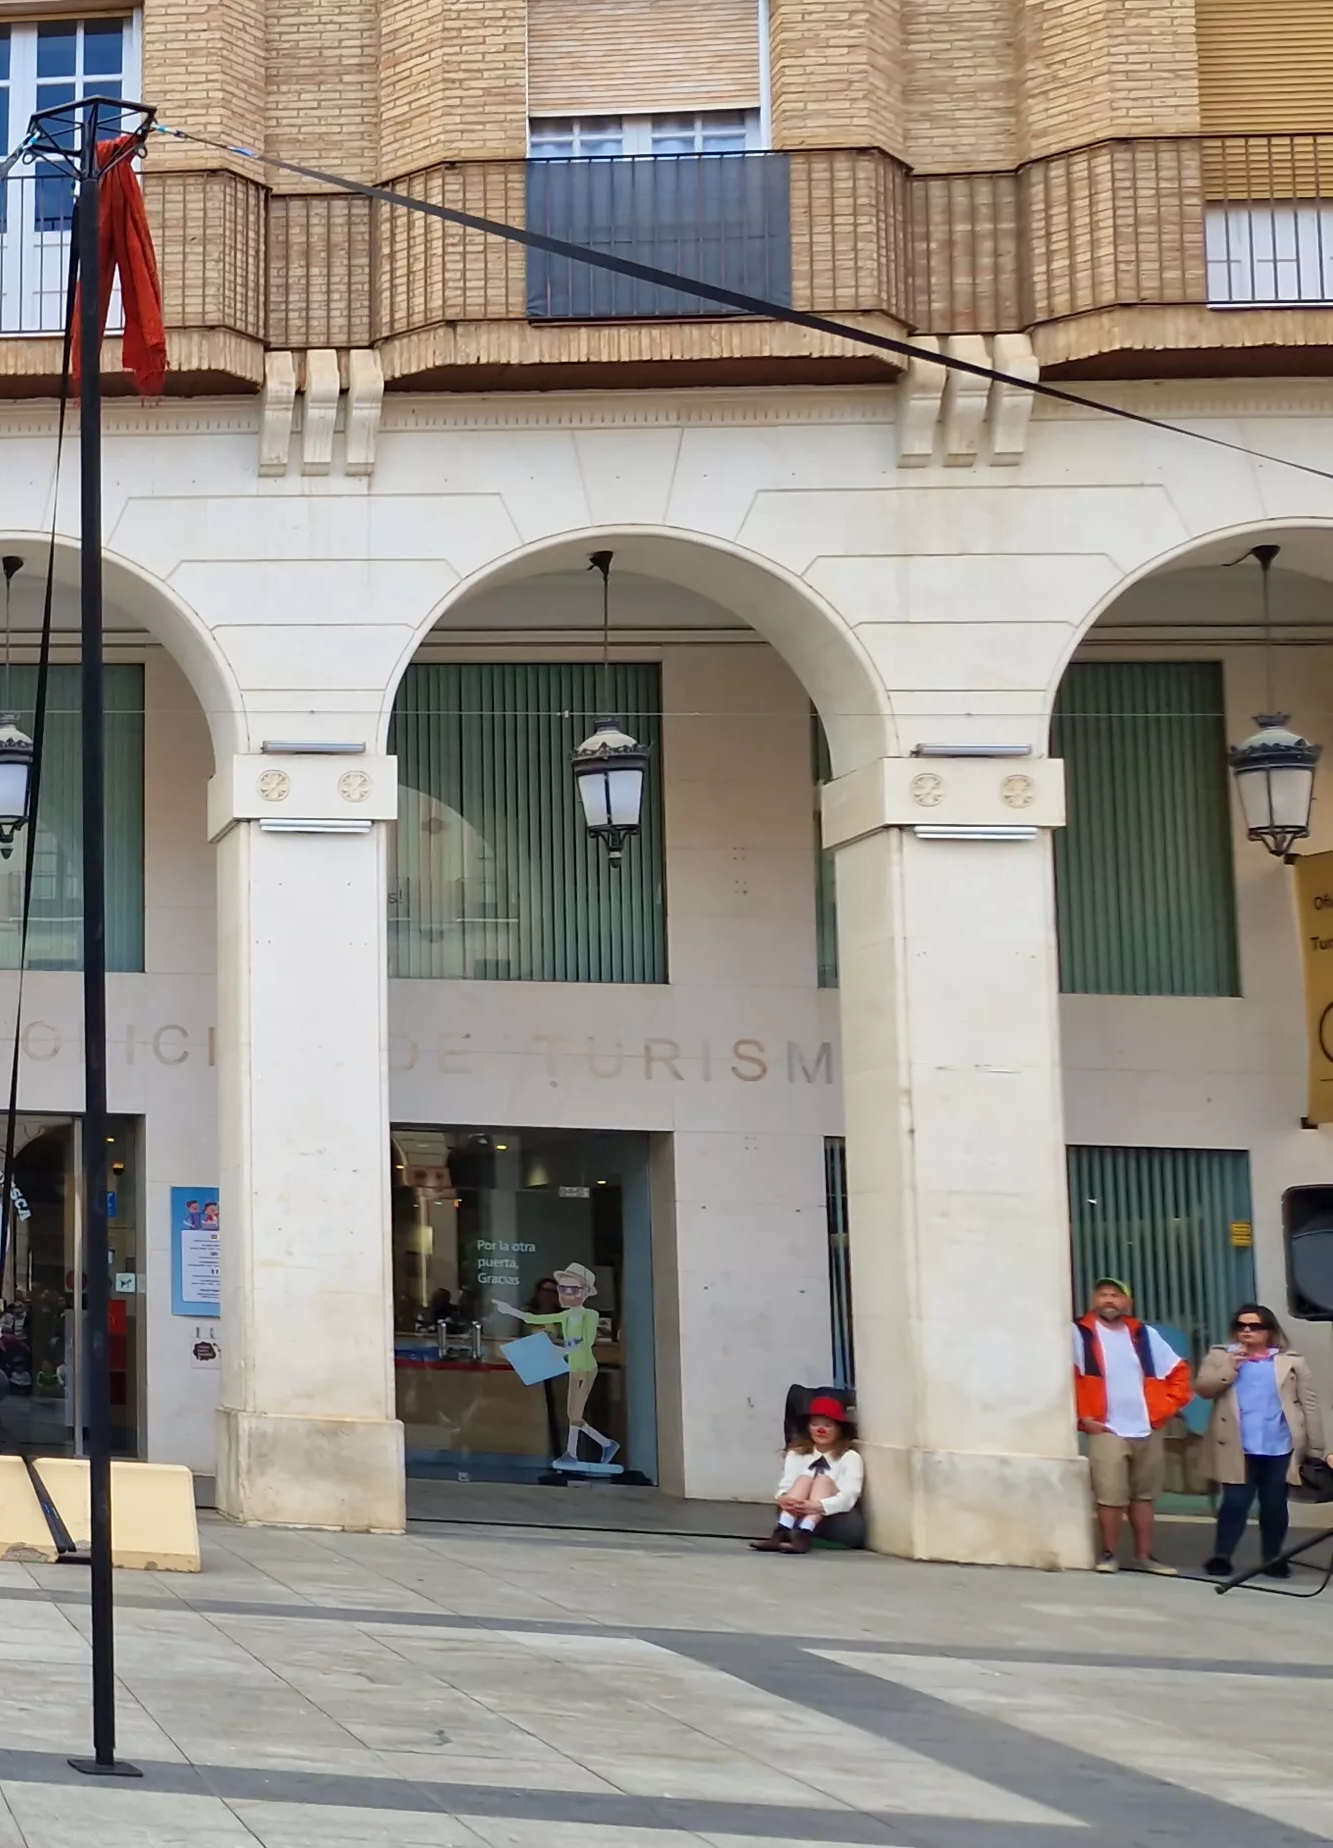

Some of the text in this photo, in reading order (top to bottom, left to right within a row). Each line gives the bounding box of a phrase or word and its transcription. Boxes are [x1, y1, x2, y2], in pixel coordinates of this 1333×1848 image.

[532, 1034, 834, 1084] TURISM
[477, 1240, 536, 1252] Por la otra
[477, 1272, 520, 1286] Gracias
